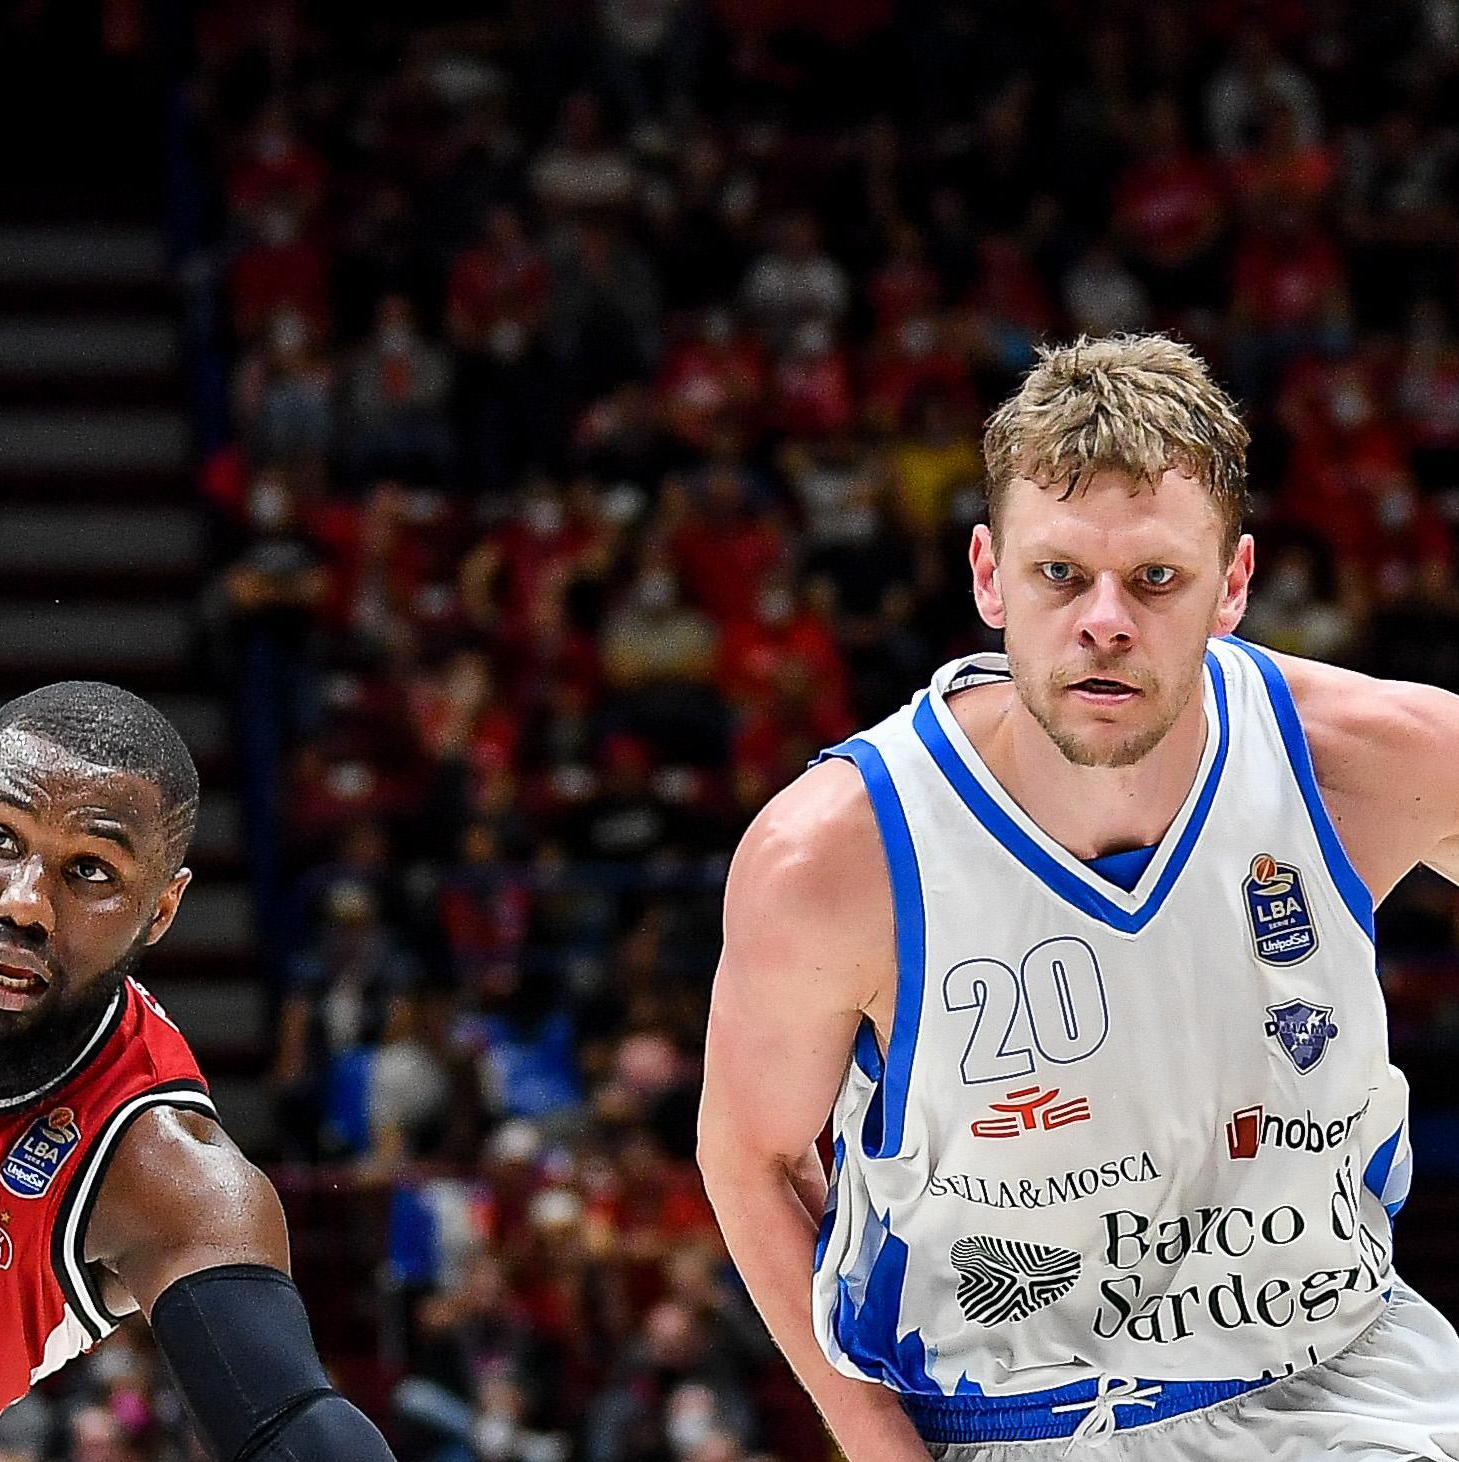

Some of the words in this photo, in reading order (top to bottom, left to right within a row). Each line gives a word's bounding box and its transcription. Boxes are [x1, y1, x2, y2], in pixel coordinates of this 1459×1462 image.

[1256, 897, 1303, 922] LBA
[942, 934, 1109, 1085] 20
[23, 1136, 59, 1164] LBA
[1261, 1098, 1370, 1154] nober
[1331, 1155, 1358, 1241] di
